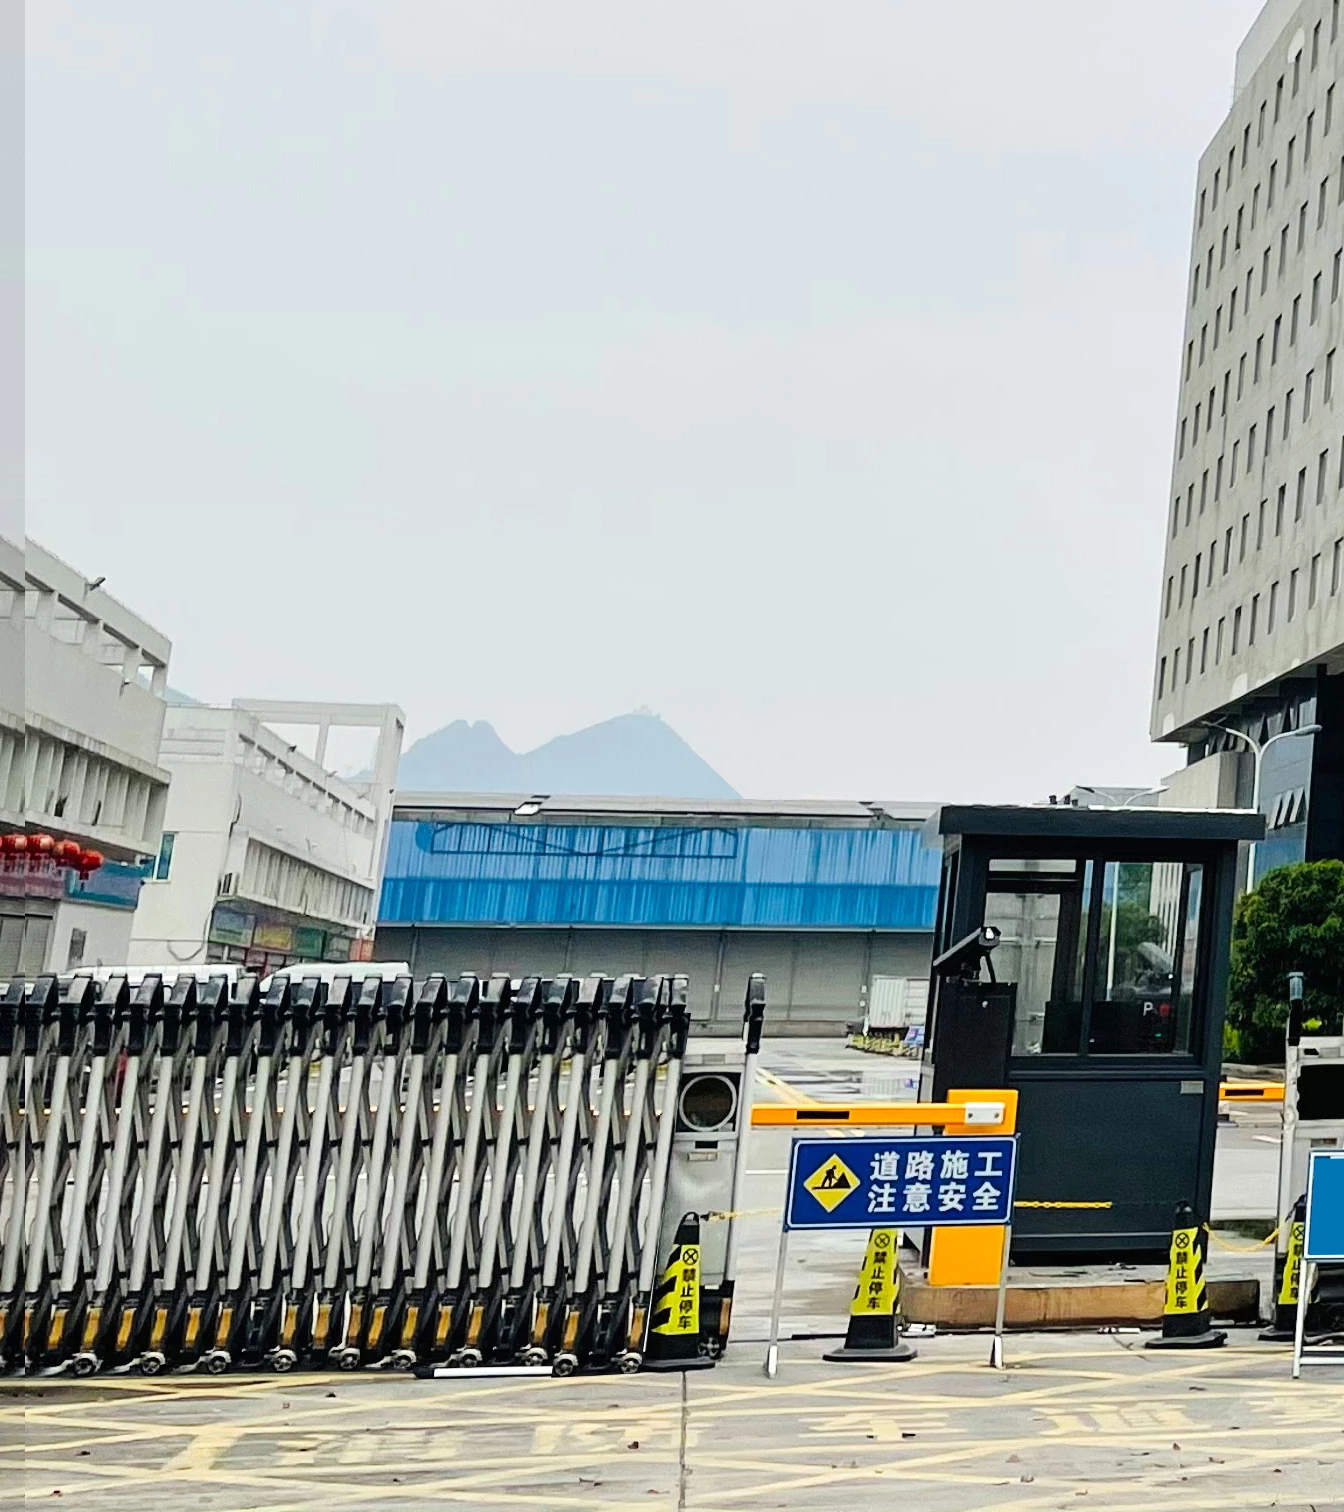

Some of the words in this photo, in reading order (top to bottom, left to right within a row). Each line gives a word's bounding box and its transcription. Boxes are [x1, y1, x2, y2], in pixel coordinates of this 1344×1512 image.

[869, 1149, 1004, 1181] 道路施工
[866, 1181, 1002, 1214] 注意安全
[678, 1268, 696, 1330] 禁止停车
